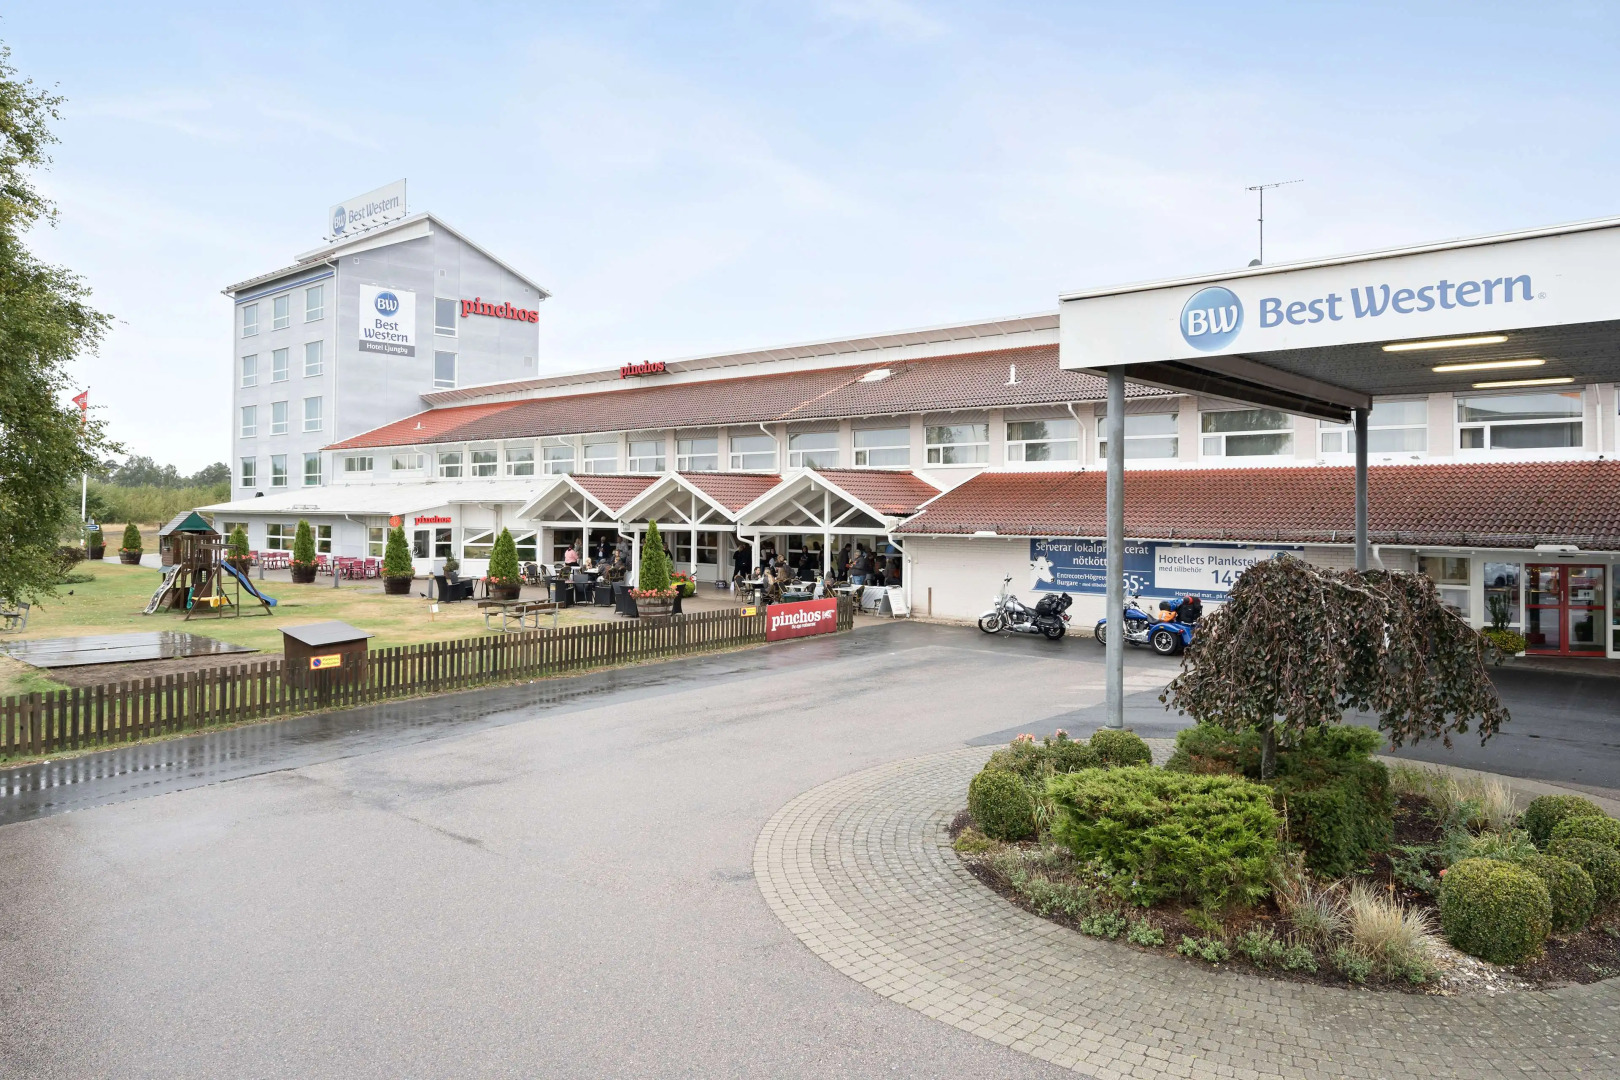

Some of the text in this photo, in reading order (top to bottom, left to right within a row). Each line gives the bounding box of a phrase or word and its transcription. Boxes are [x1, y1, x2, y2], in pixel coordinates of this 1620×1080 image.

[348, 195, 399, 224] Best Western
[377, 297, 398, 312] BW
[1259, 274, 1535, 329] Best Western
[460, 296, 540, 324] pinchos
[375, 318, 399, 332] Best
[1187, 304, 1239, 337] BW
[363, 327, 409, 343] Western
[366, 342, 408, 355] Hotel Ljungby
[620, 360, 666, 380] pinchos
[414, 514, 452, 526] pinchos
[1035, 542, 1073, 553] Serverar
[1158, 554, 1205, 566] Hotellets
[1158, 565, 1202, 574] med tillbehör
[1056, 579, 1079, 588] Burgare
[771, 608, 821, 632] pinchos
